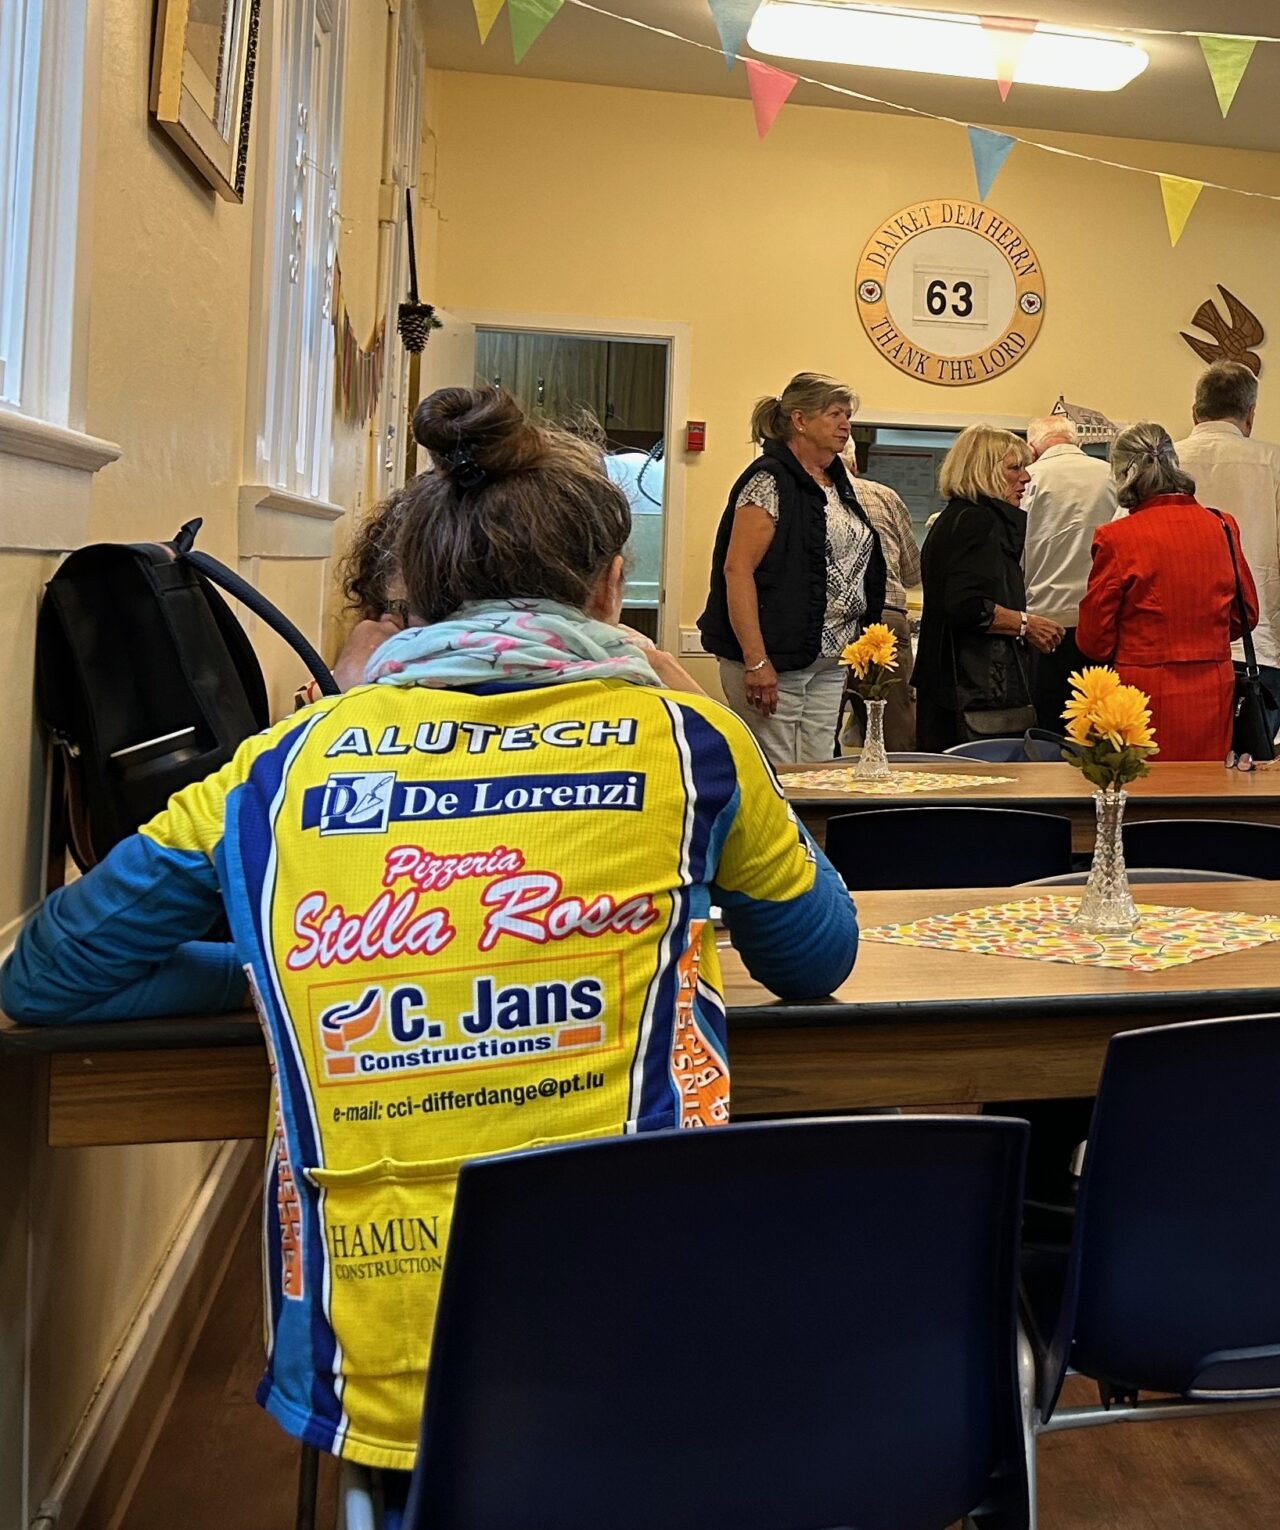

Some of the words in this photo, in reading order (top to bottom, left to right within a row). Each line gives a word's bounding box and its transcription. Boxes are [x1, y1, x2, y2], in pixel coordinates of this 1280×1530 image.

[866, 207, 932, 269] DANKET
[941, 203, 984, 230] DEM
[984, 216, 1037, 278] HERRN
[926, 279, 973, 317] 63
[870, 316, 931, 376] THANK
[937, 359, 977, 381] THE
[978, 331, 1027, 375] LORD
[325, 718, 637, 757] ALUTECH
[400, 785, 460, 817] De
[470, 776, 638, 813] Lorenzi
[384, 847, 523, 890] Pizzeria
[288, 891, 454, 969] Stella
[477, 871, 660, 953] Rosa
[390, 987, 442, 1042] C.
[462, 979, 603, 1034] Jans
[360, 1034, 552, 1072] Constructions
[333, 1101, 383, 1123] e-mail:
[386, 1071, 605, 1119] cci-differdange@pt.lu
[330, 1216, 439, 1258] HAMUN
